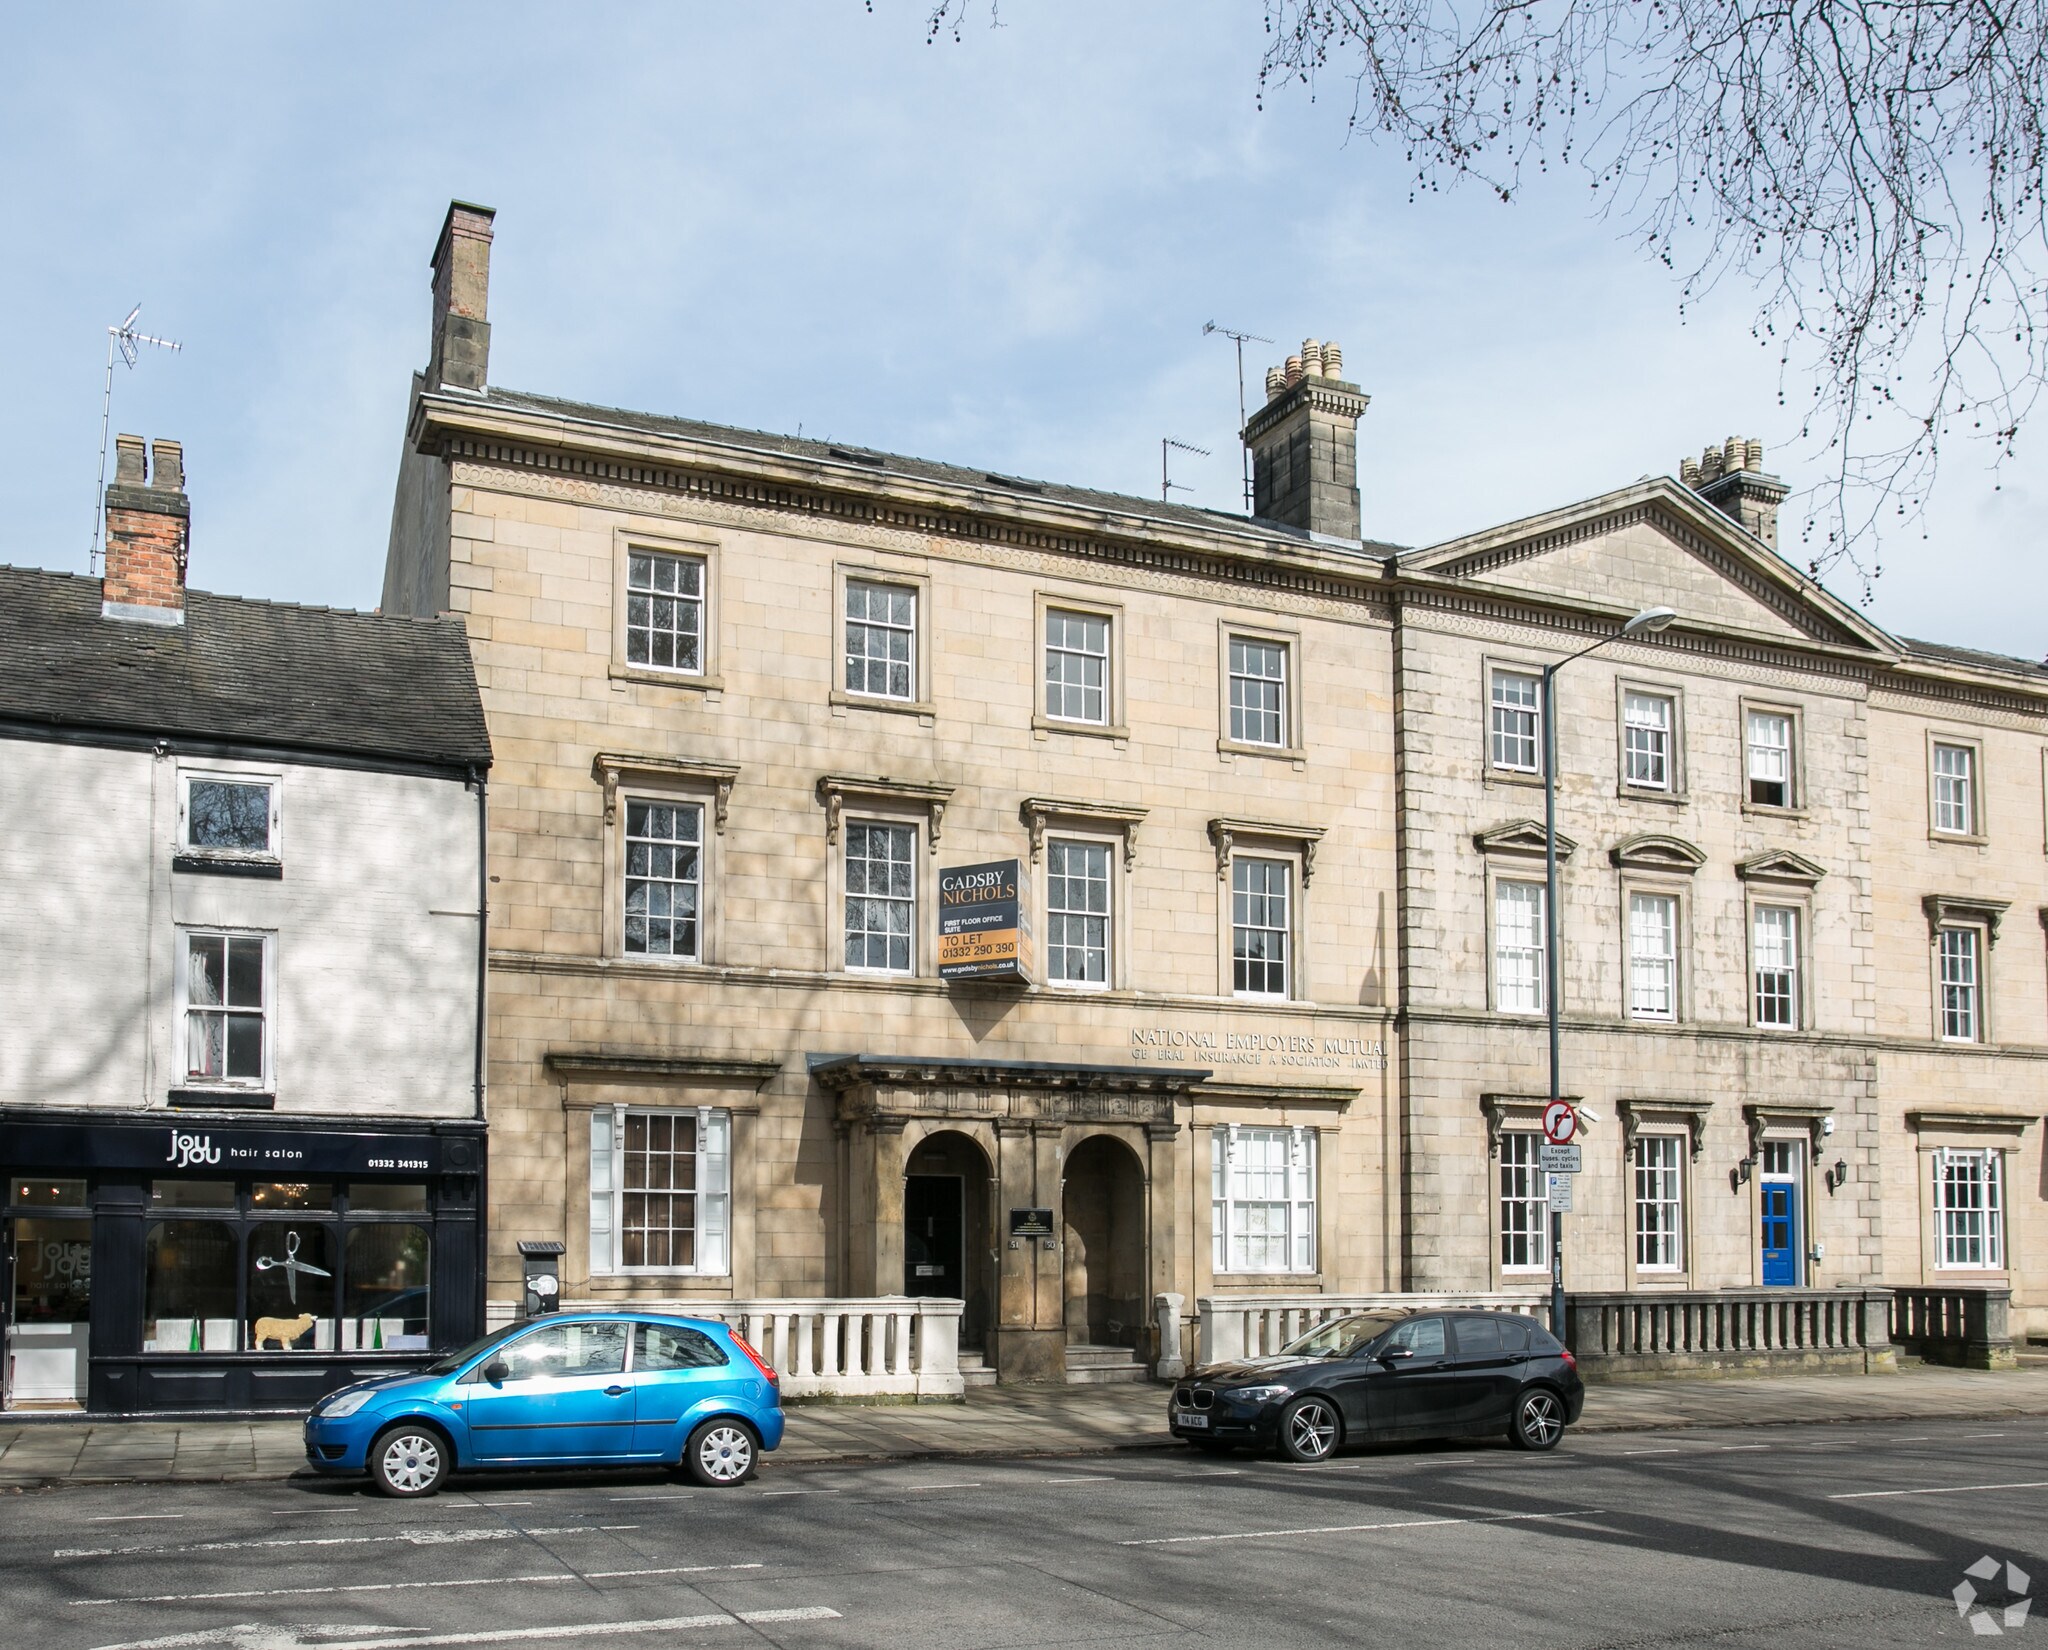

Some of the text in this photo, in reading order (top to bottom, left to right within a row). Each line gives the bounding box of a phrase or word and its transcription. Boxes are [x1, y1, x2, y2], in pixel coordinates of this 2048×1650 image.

[942, 871, 1004, 891] GADSBY
[943, 884, 1015, 905] NICHOLS
[944, 915, 1003, 927] FIRST FLOOR OFFICE
[944, 926, 961, 934] SUITE
[945, 933, 983, 946] TO LET
[942, 943, 1014, 959] 01332 290 390
[942, 961, 1015, 974] www.gadsbynichols.co.uk
[1131, 1028, 1388, 1056] NATIONAL EMPLOYERS MUTUAL
[1194, 1050, 1261, 1065] INSURANCE
[230, 1148, 259, 1158] hair
[264, 1149, 303, 1159] salon
[1550, 1147, 1570, 1155] Except
[368, 1158, 429, 1169] 01332 341315
[1010, 1240, 1019, 1248] 51
[1046, 1240, 1056, 1248] 50
[30, 1281, 49, 1289] hair
